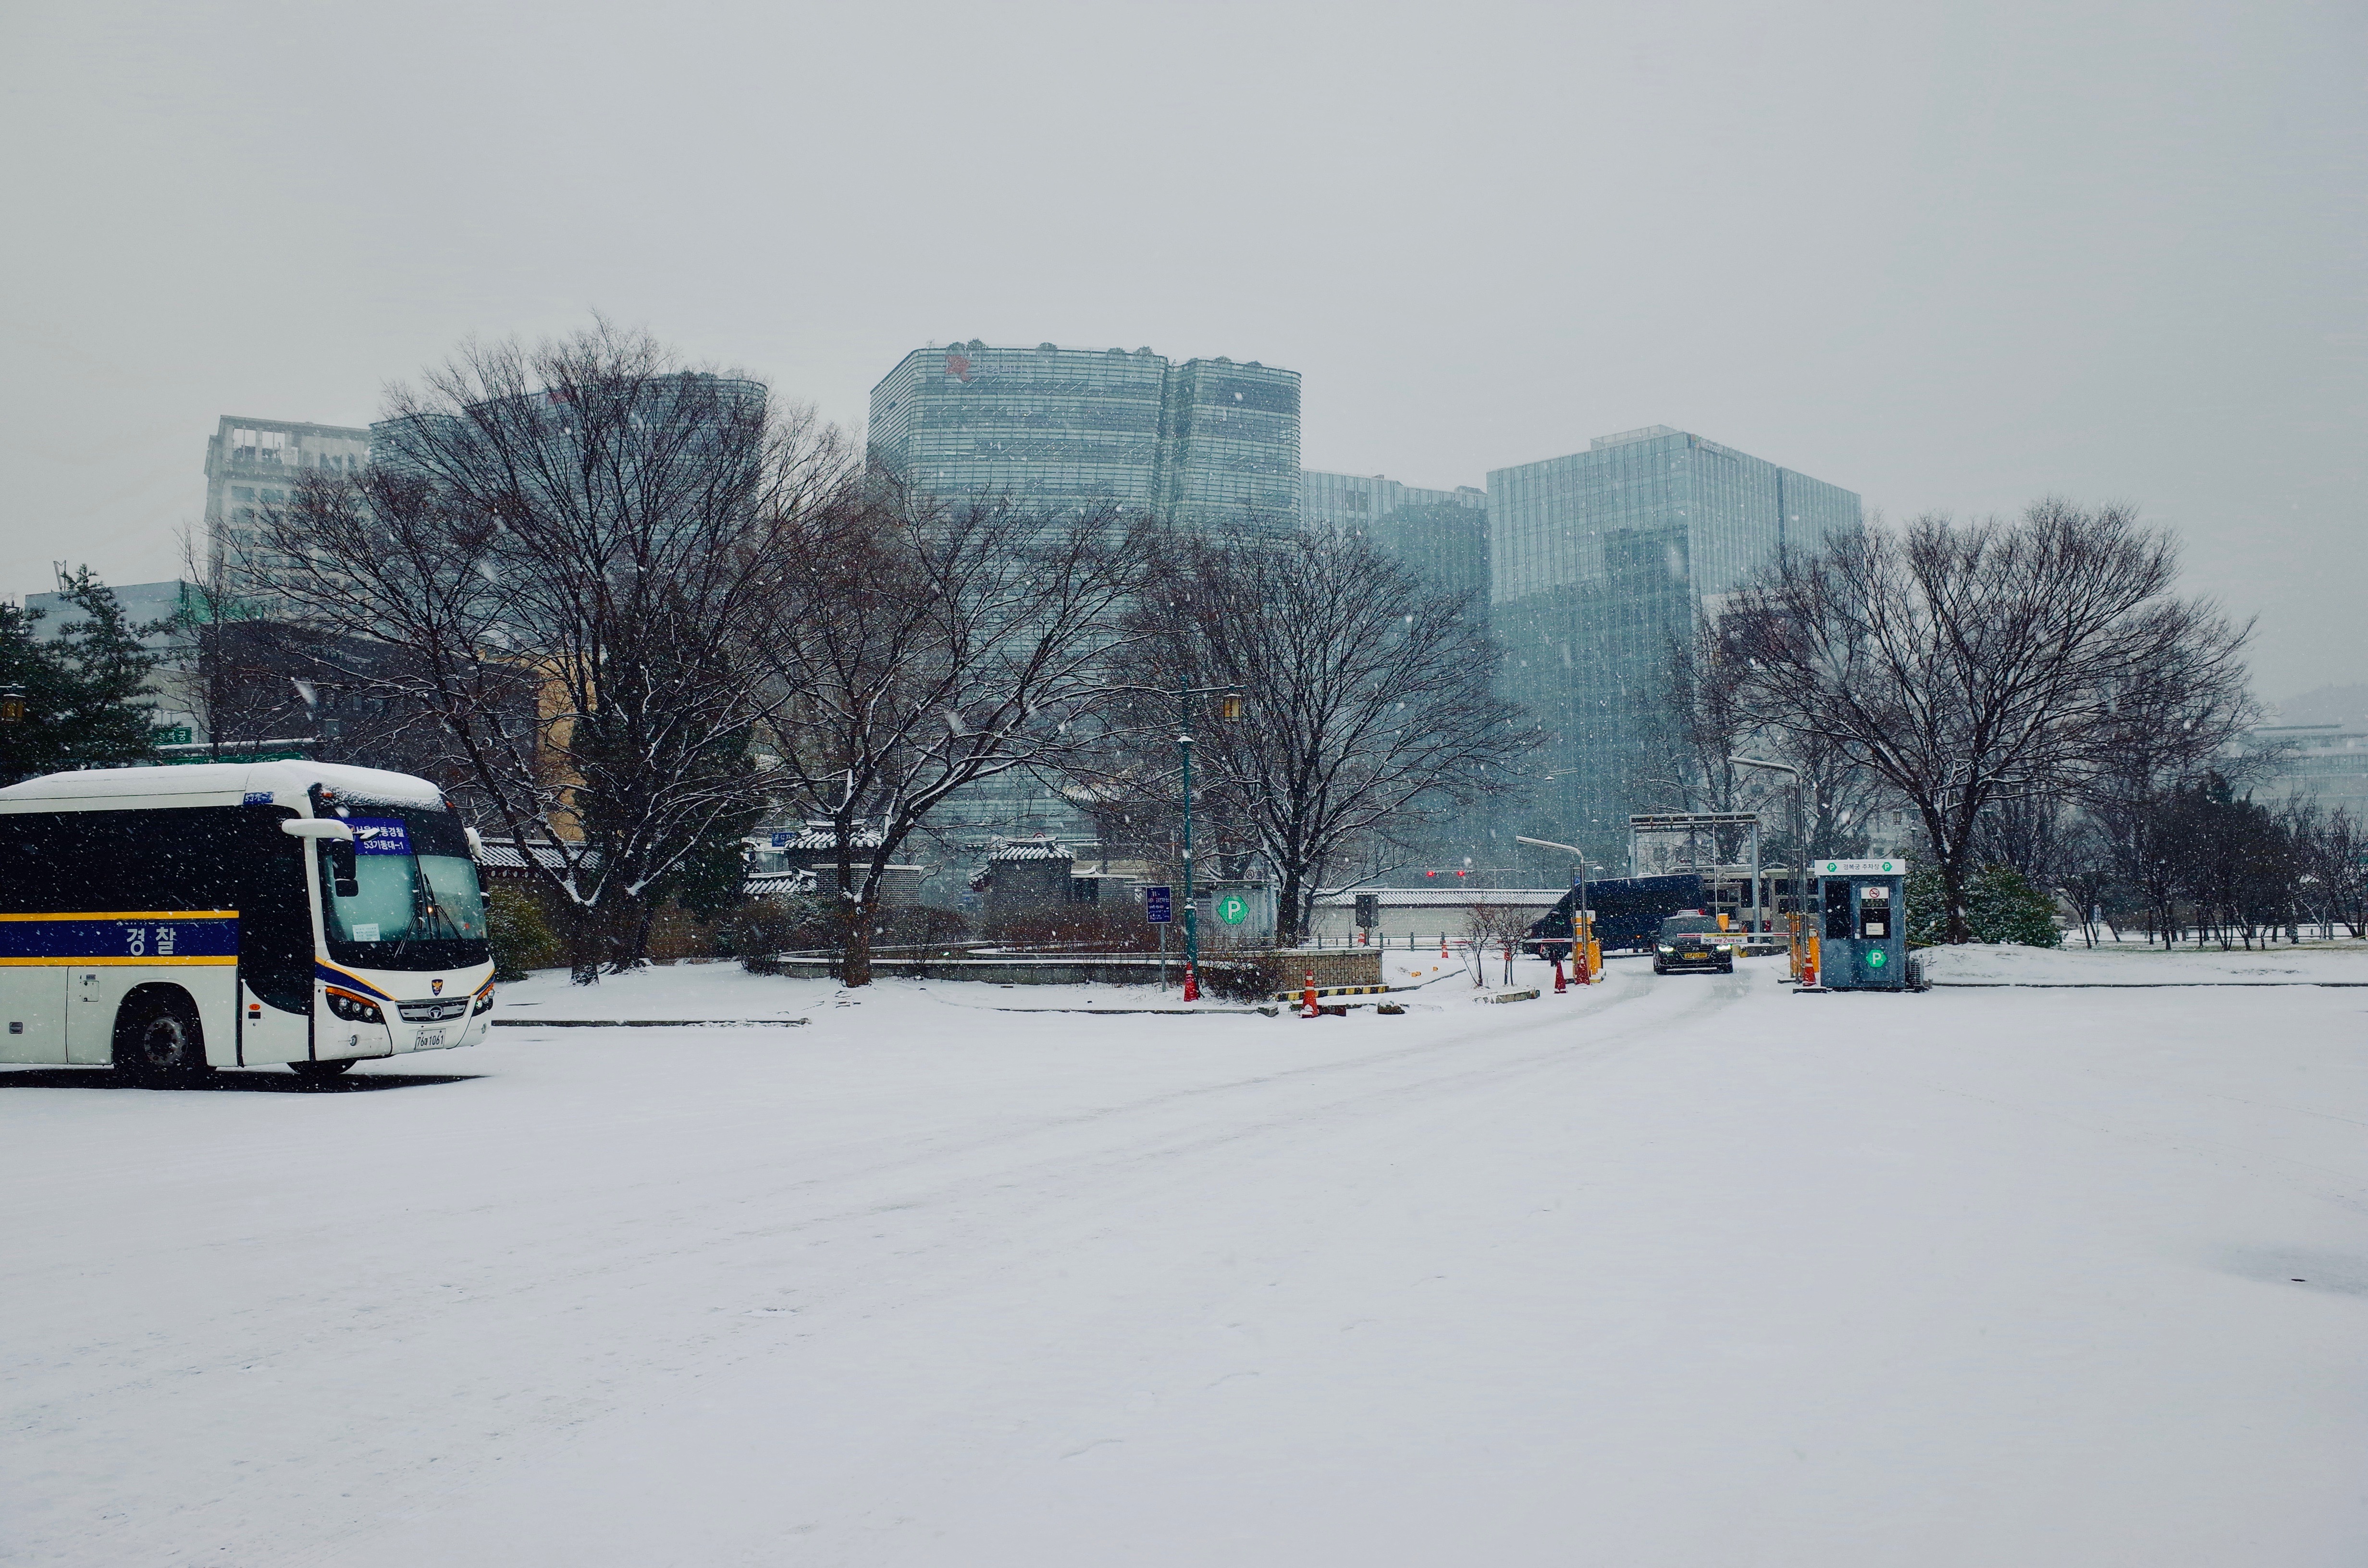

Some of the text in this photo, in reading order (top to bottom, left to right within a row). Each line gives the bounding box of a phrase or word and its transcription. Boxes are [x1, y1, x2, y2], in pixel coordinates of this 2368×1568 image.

[356, 826, 404, 837] 서동경찰
[364, 841, 404, 850] 53기동대-1
[1228, 900, 1241, 919] P
[126, 926, 176, 956] 경찰
[1872, 952, 1882, 965] P
